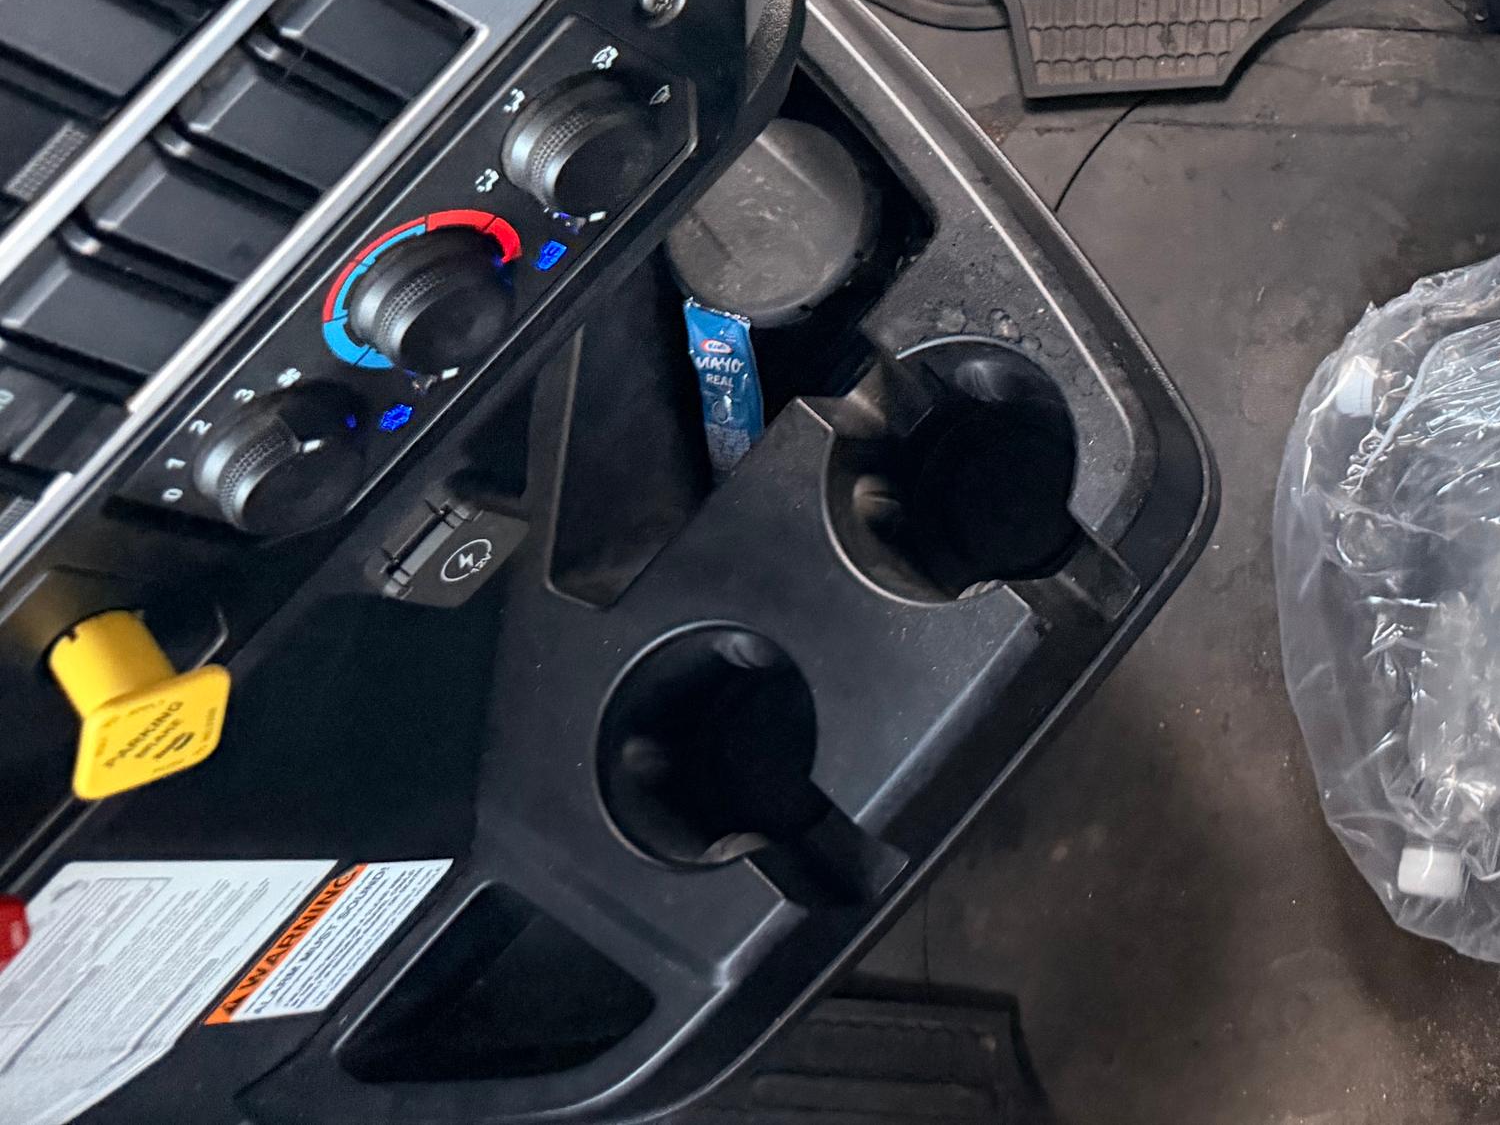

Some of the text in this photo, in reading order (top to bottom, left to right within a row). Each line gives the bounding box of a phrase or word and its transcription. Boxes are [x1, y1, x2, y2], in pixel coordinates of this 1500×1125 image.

[694, 356, 744, 374] MAYO
[706, 373, 734, 388] REAL
[233, 389, 255, 403] 3
[189, 419, 212, 435] 2
[165, 457, 186, 470] 1
[162, 488, 183, 502] 0
[103, 701, 184, 768] PARKING
[236, 870, 359, 991] WARNING
